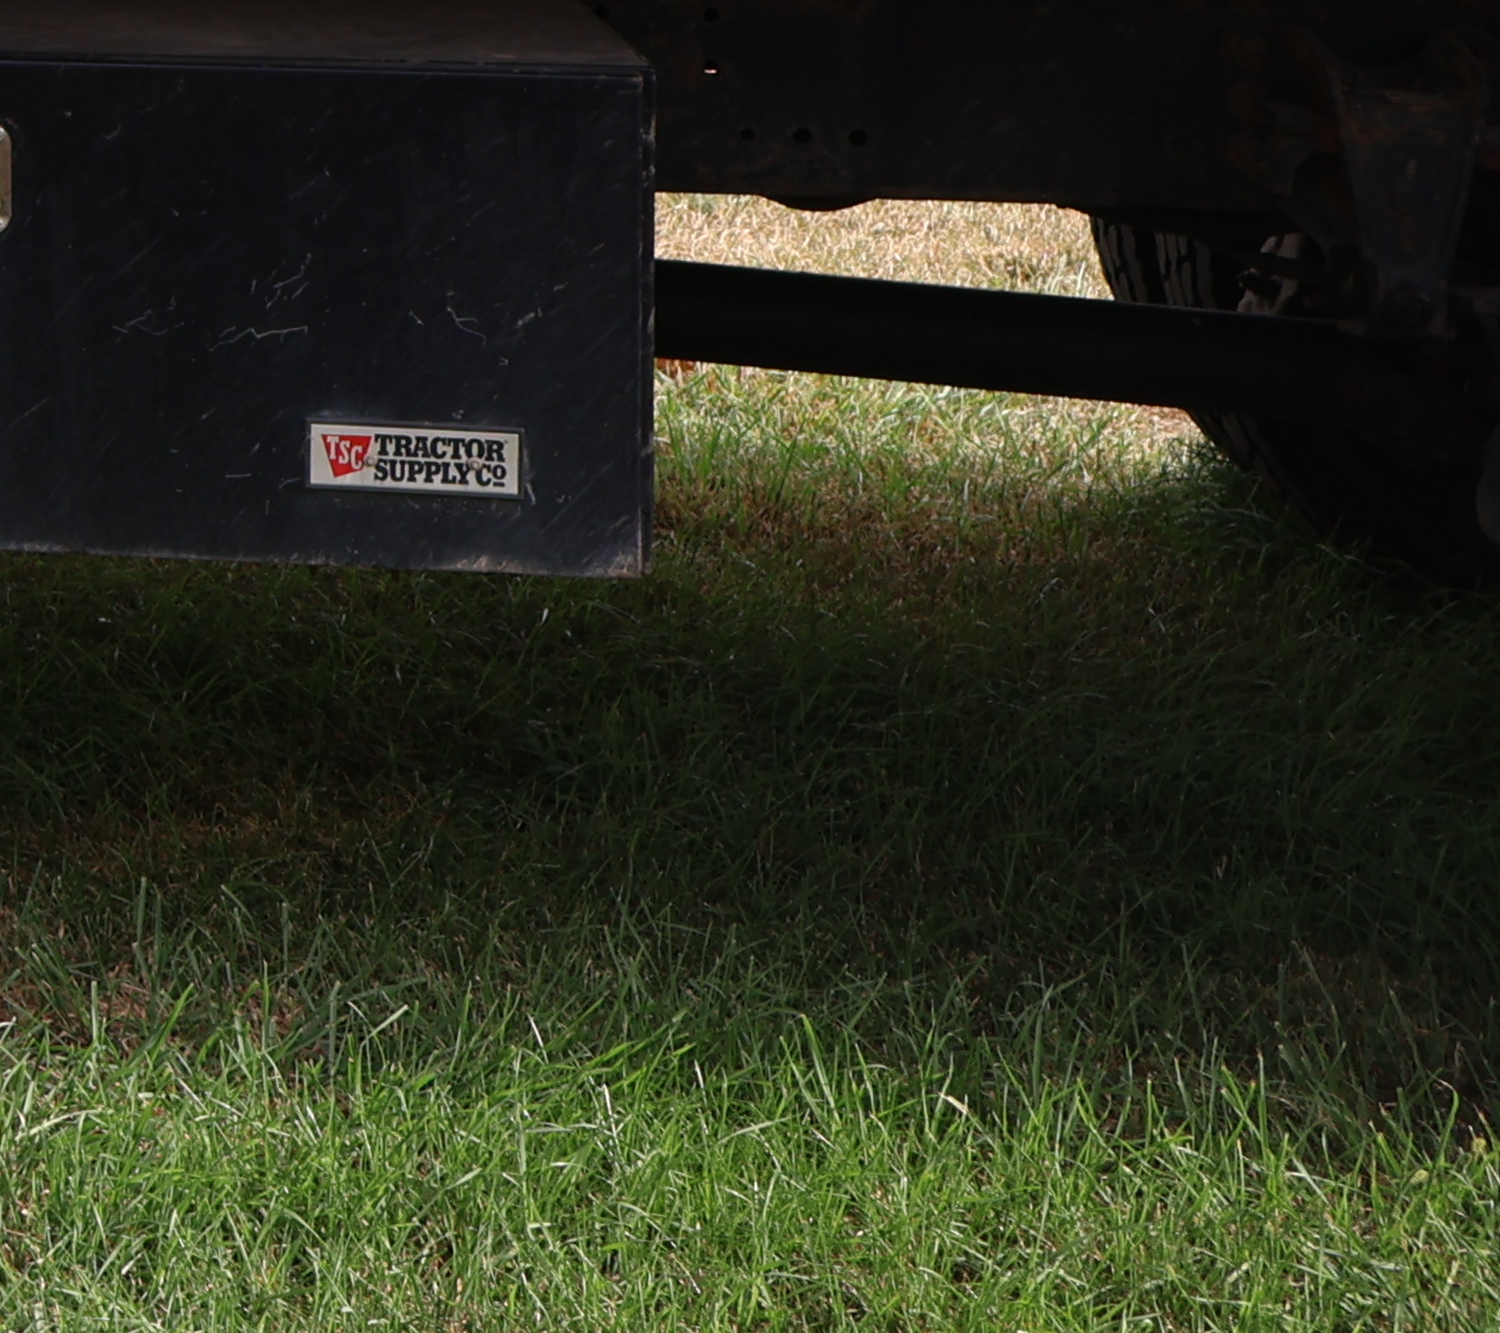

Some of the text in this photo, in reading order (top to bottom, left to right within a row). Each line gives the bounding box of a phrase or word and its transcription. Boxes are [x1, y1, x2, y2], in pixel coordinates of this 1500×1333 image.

[327, 435, 363, 470] TSC
[374, 434, 506, 463] TRACTOR
[373, 458, 470, 485] SUPPLY
